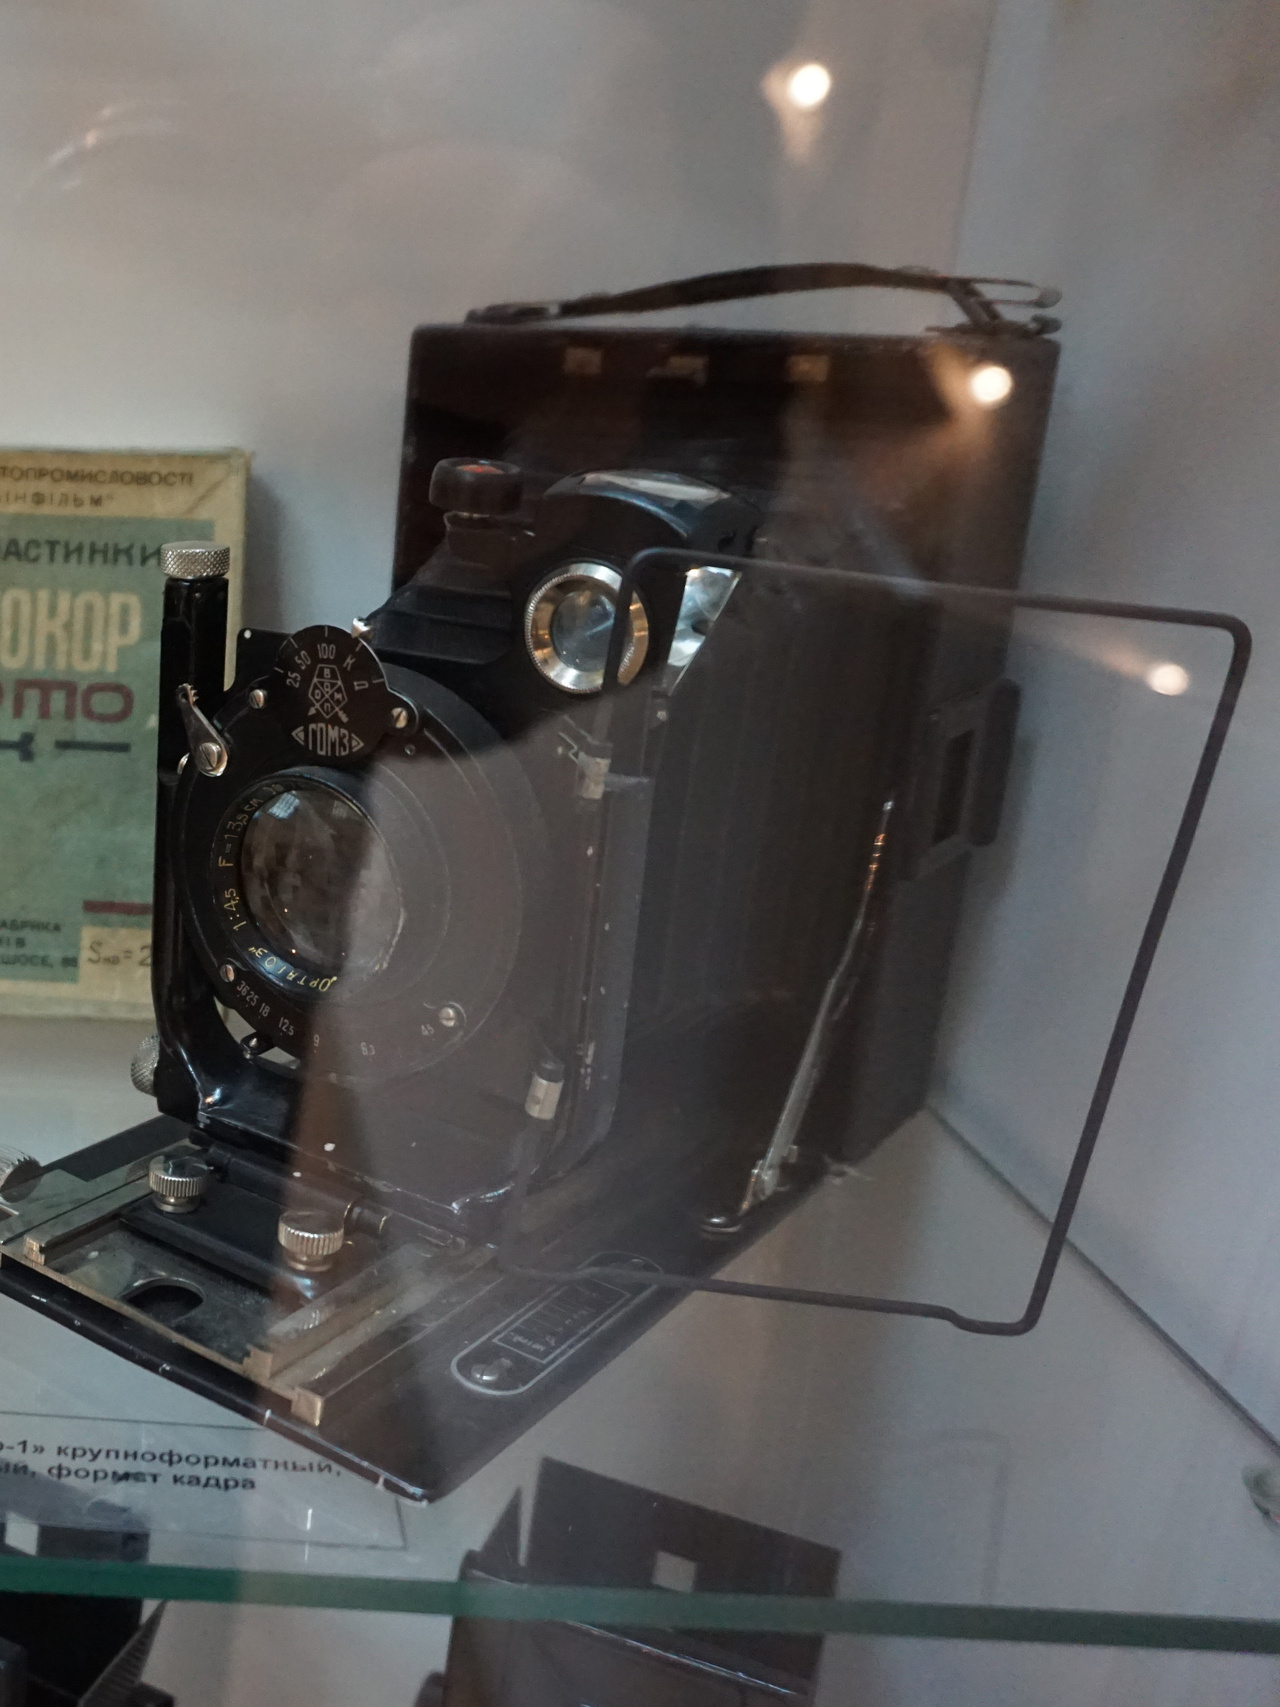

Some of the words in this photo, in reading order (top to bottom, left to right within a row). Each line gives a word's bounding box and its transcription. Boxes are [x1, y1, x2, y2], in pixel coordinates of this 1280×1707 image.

[295, 650, 312, 670] 50
[317, 643, 336, 660] 100
[286, 671, 301, 688] 25
[308, 722, 350, 757] ГОМЗ
[55, 1442, 343, 1478] крупноформатный,
[46, 1462, 160, 1488] формат
[171, 1471, 257, 1494] кадра
